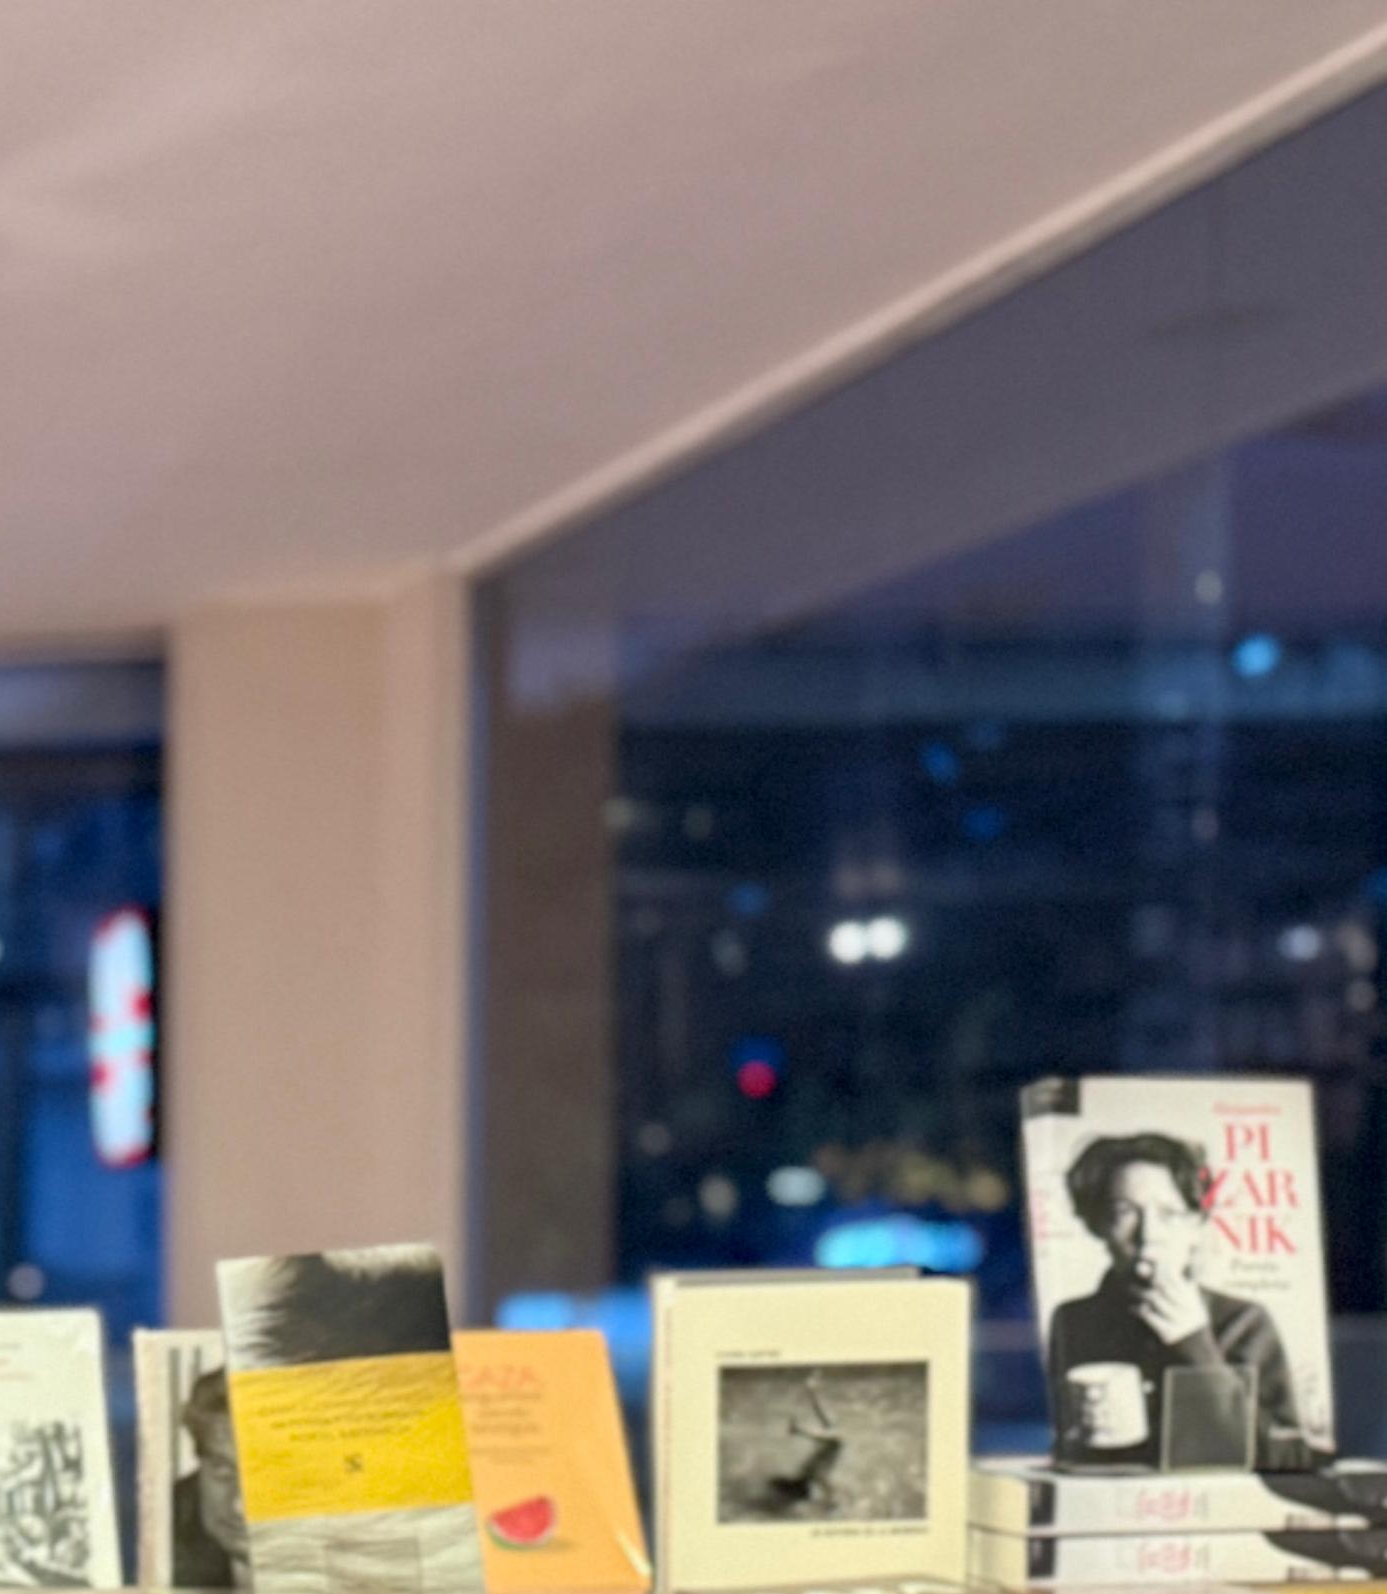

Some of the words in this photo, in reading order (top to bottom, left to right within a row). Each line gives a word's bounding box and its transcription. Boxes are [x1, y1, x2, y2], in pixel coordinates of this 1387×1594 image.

[1224, 1122, 1271, 1163] PI
[1199, 1167, 1300, 1209] ZAR
[1210, 1214, 1298, 1255] NIK
